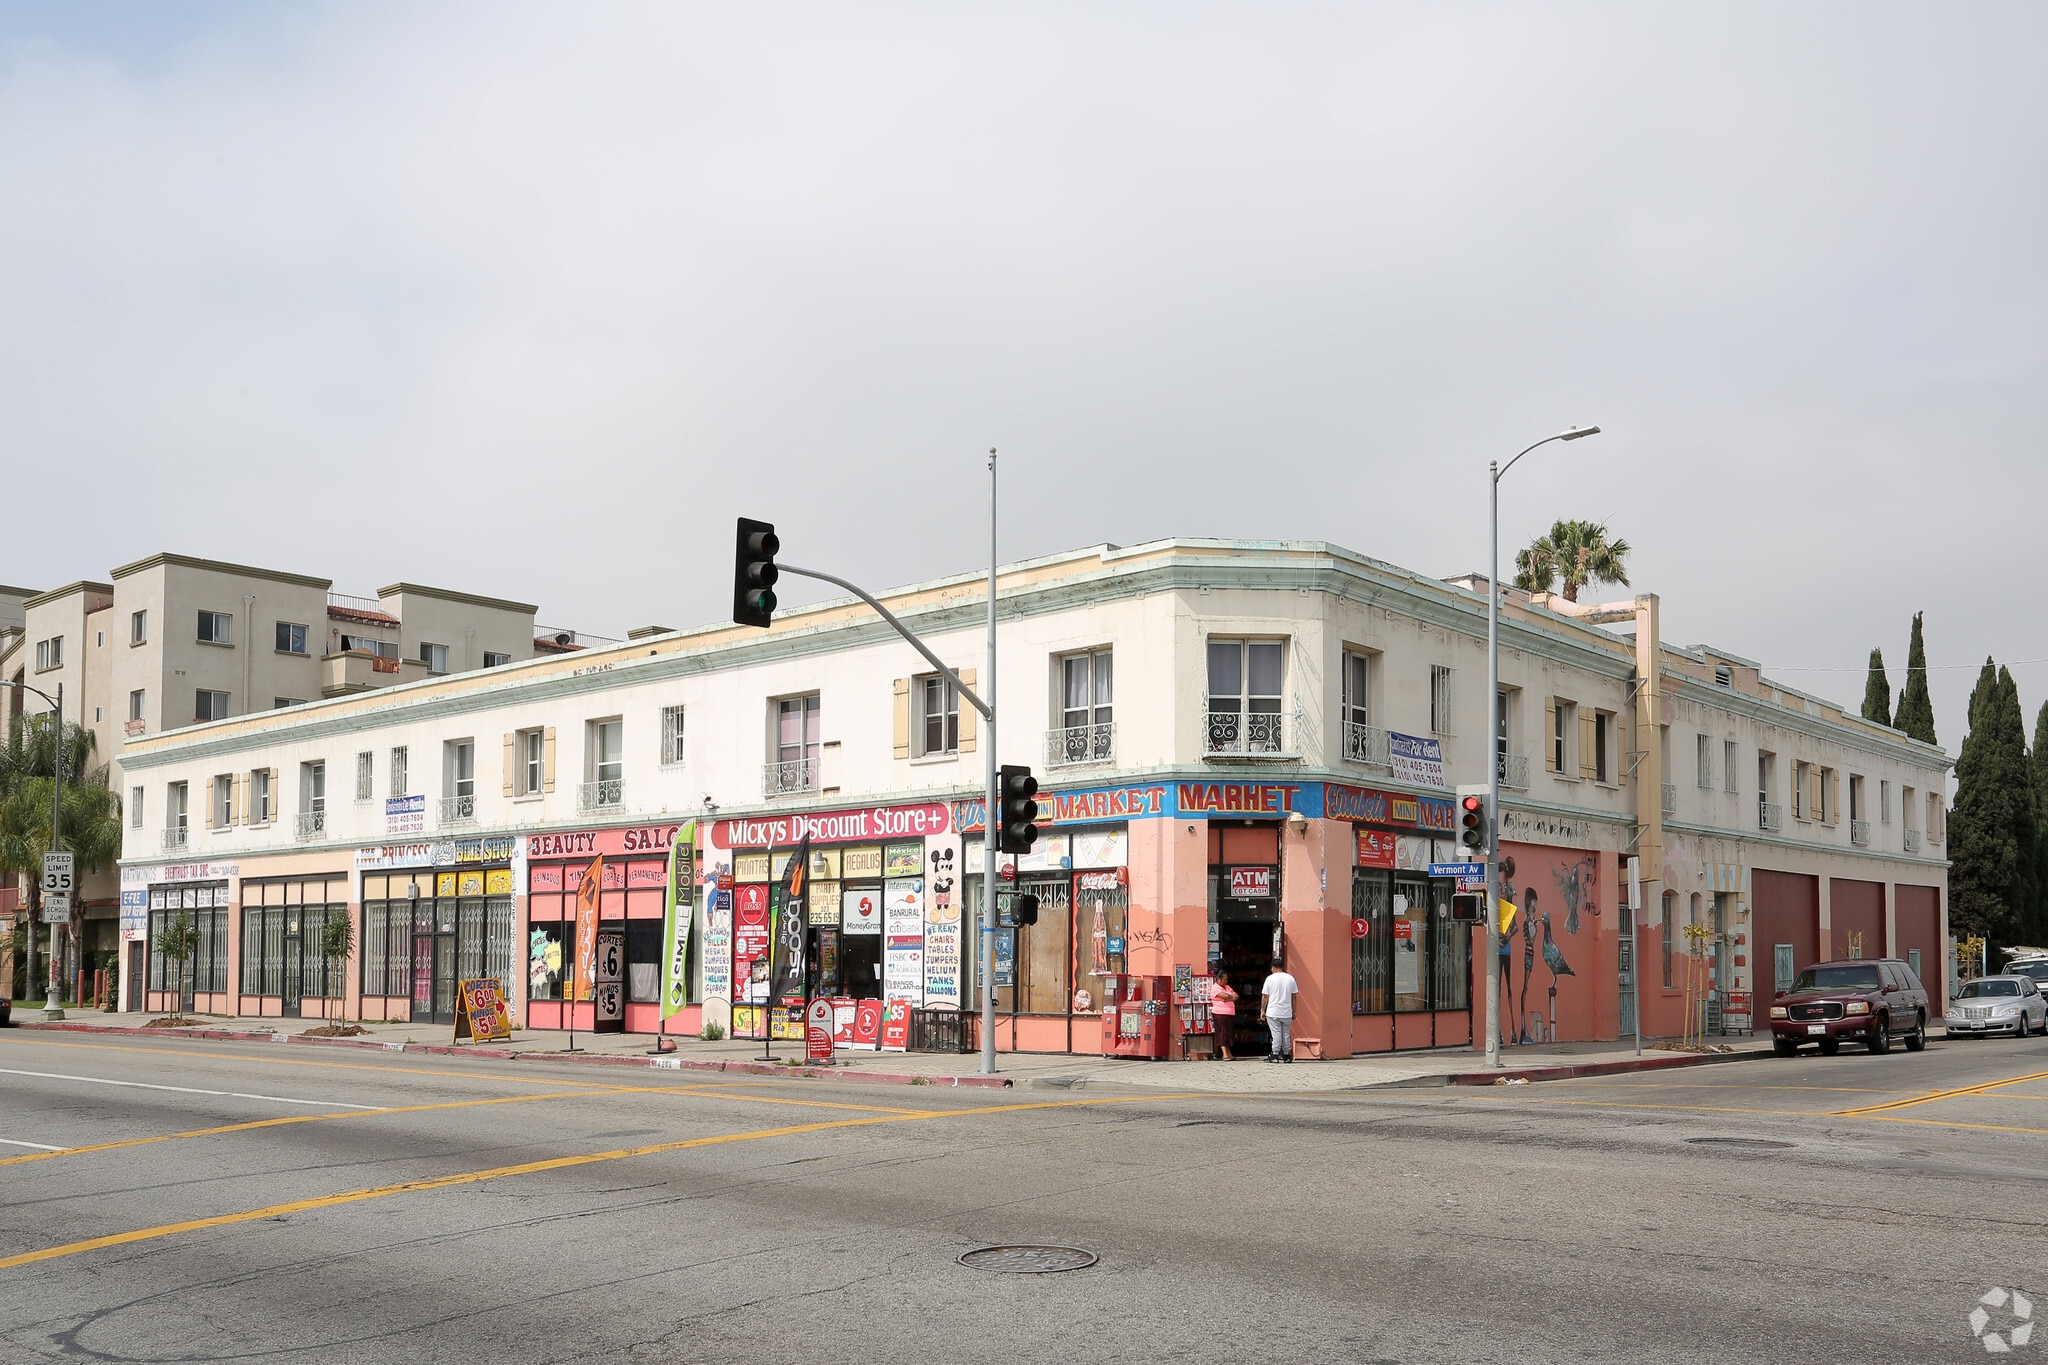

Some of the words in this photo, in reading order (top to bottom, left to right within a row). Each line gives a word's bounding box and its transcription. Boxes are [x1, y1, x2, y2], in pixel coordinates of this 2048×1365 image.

[1411, 740, 1422, 756] For
[1423, 741, 1441, 759] Rent
[1393, 757, 1408, 769] (310)
[1410, 761, 1442, 774] 405-7604
[1395, 769, 1412, 781] (310)
[1055, 786, 1166, 821] MARKET
[1327, 785, 1387, 823] Elisabeth
[1395, 802, 1417, 820] MINI
[1419, 801, 1456, 831] MAR
[792, 809, 868, 842] Discount
[532, 832, 597, 856] BEAUTY
[624, 826, 681, 850] SALO
[382, 844, 431, 867] PRINCESS
[455, 839, 482, 864] BIKE
[483, 836, 516, 863] SHOP
[737, 857, 768, 876] PIÑATAS
[846, 853, 881, 871] REGALOS
[190, 865, 198, 878] TAX
[677, 845, 691, 903] Mobile
[1433, 865, 1466, 874] Vermont
[1468, 865, 1479, 874] Av
[46, 874, 71, 888] 35
[533, 872, 560, 886] PEINADOS
[603, 873, 624, 884] CORTES
[1233, 871, 1268, 885] ATM
[816, 883, 836, 894] PARTY
[744, 902, 761, 910] BOSS
[810, 895, 840, 906] SUPPLIES
[889, 908, 920, 918] BANRURAL
[926, 926, 936, 935] WE
[939, 925, 958, 935] RENT
[1208, 926, 1216, 935] A
[598, 935, 623, 947] CORTES
[929, 935, 954, 944] CHAIRS
[705, 947, 726, 955] MESAS
[928, 945, 955, 954] TABLES
[602, 946, 617, 976] $6
[889, 953, 909, 961] HSBC
[926, 955, 959, 965] JUMPERS
[705, 966, 729, 974] TANQUES
[927, 966, 957, 975] HELIUM
[927, 976, 955, 985] TANKS
[464, 980, 500, 994] CORTES
[926, 986, 958, 997] BALLOONS
[602, 993, 616, 1015] $5
[890, 1004, 905, 1021] $5
[774, 1024, 785, 1032] Ria
